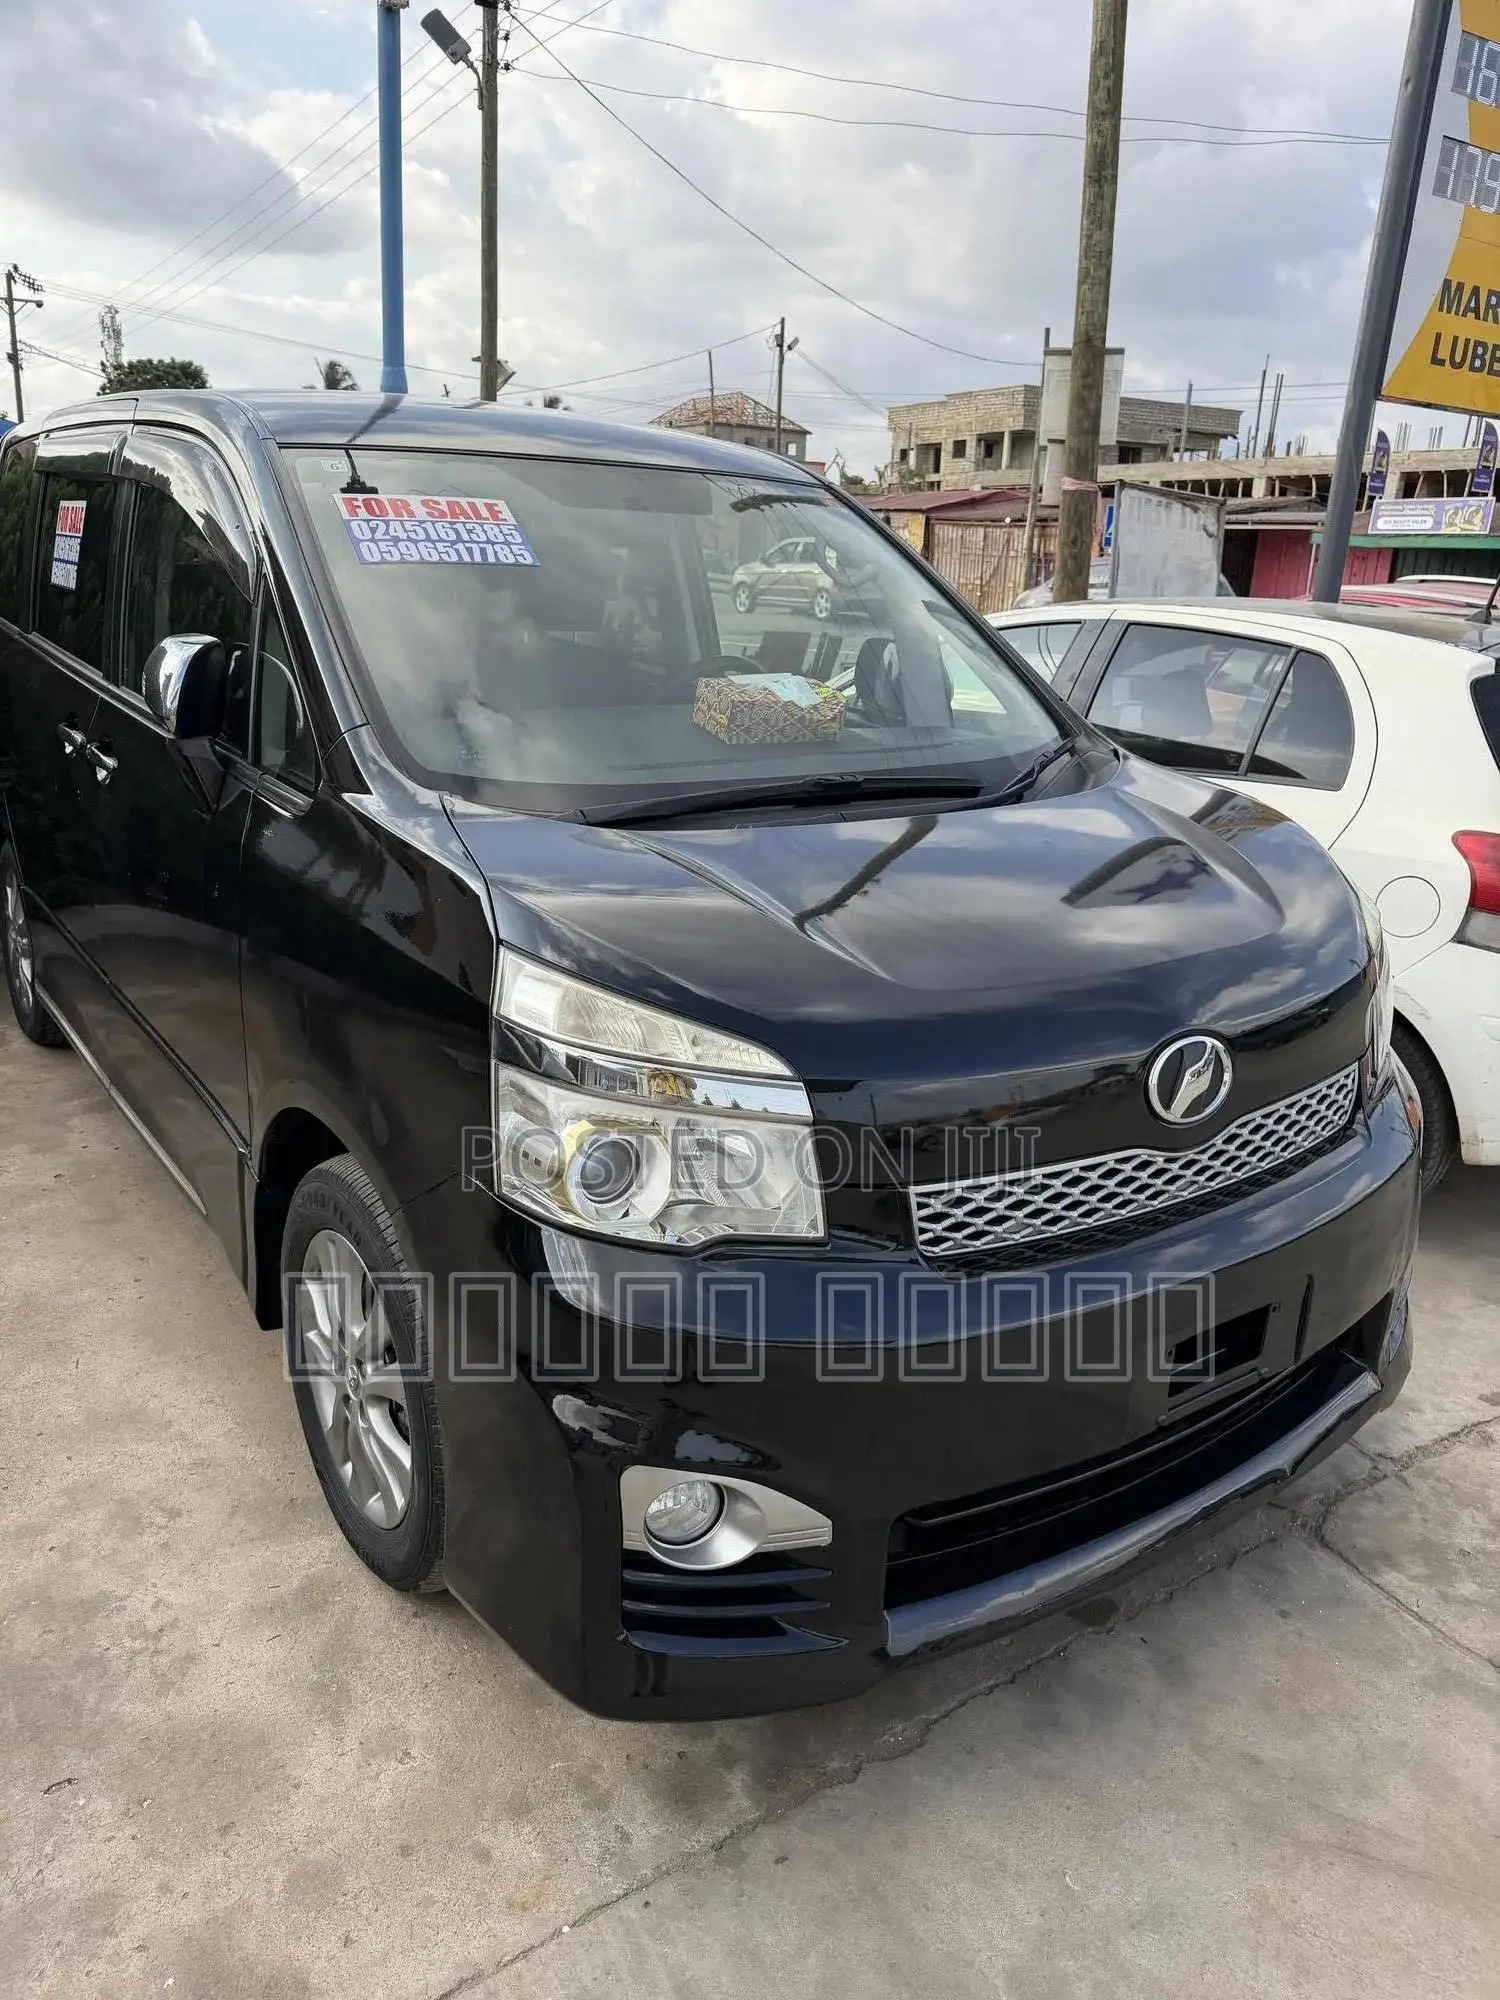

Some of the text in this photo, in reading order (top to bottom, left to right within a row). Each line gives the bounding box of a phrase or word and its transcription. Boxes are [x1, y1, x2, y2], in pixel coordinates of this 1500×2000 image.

[341, 497, 509, 523] FOR SALE
[351, 520, 524, 544] 0245161385
[359, 541, 534, 564] 0596517785
